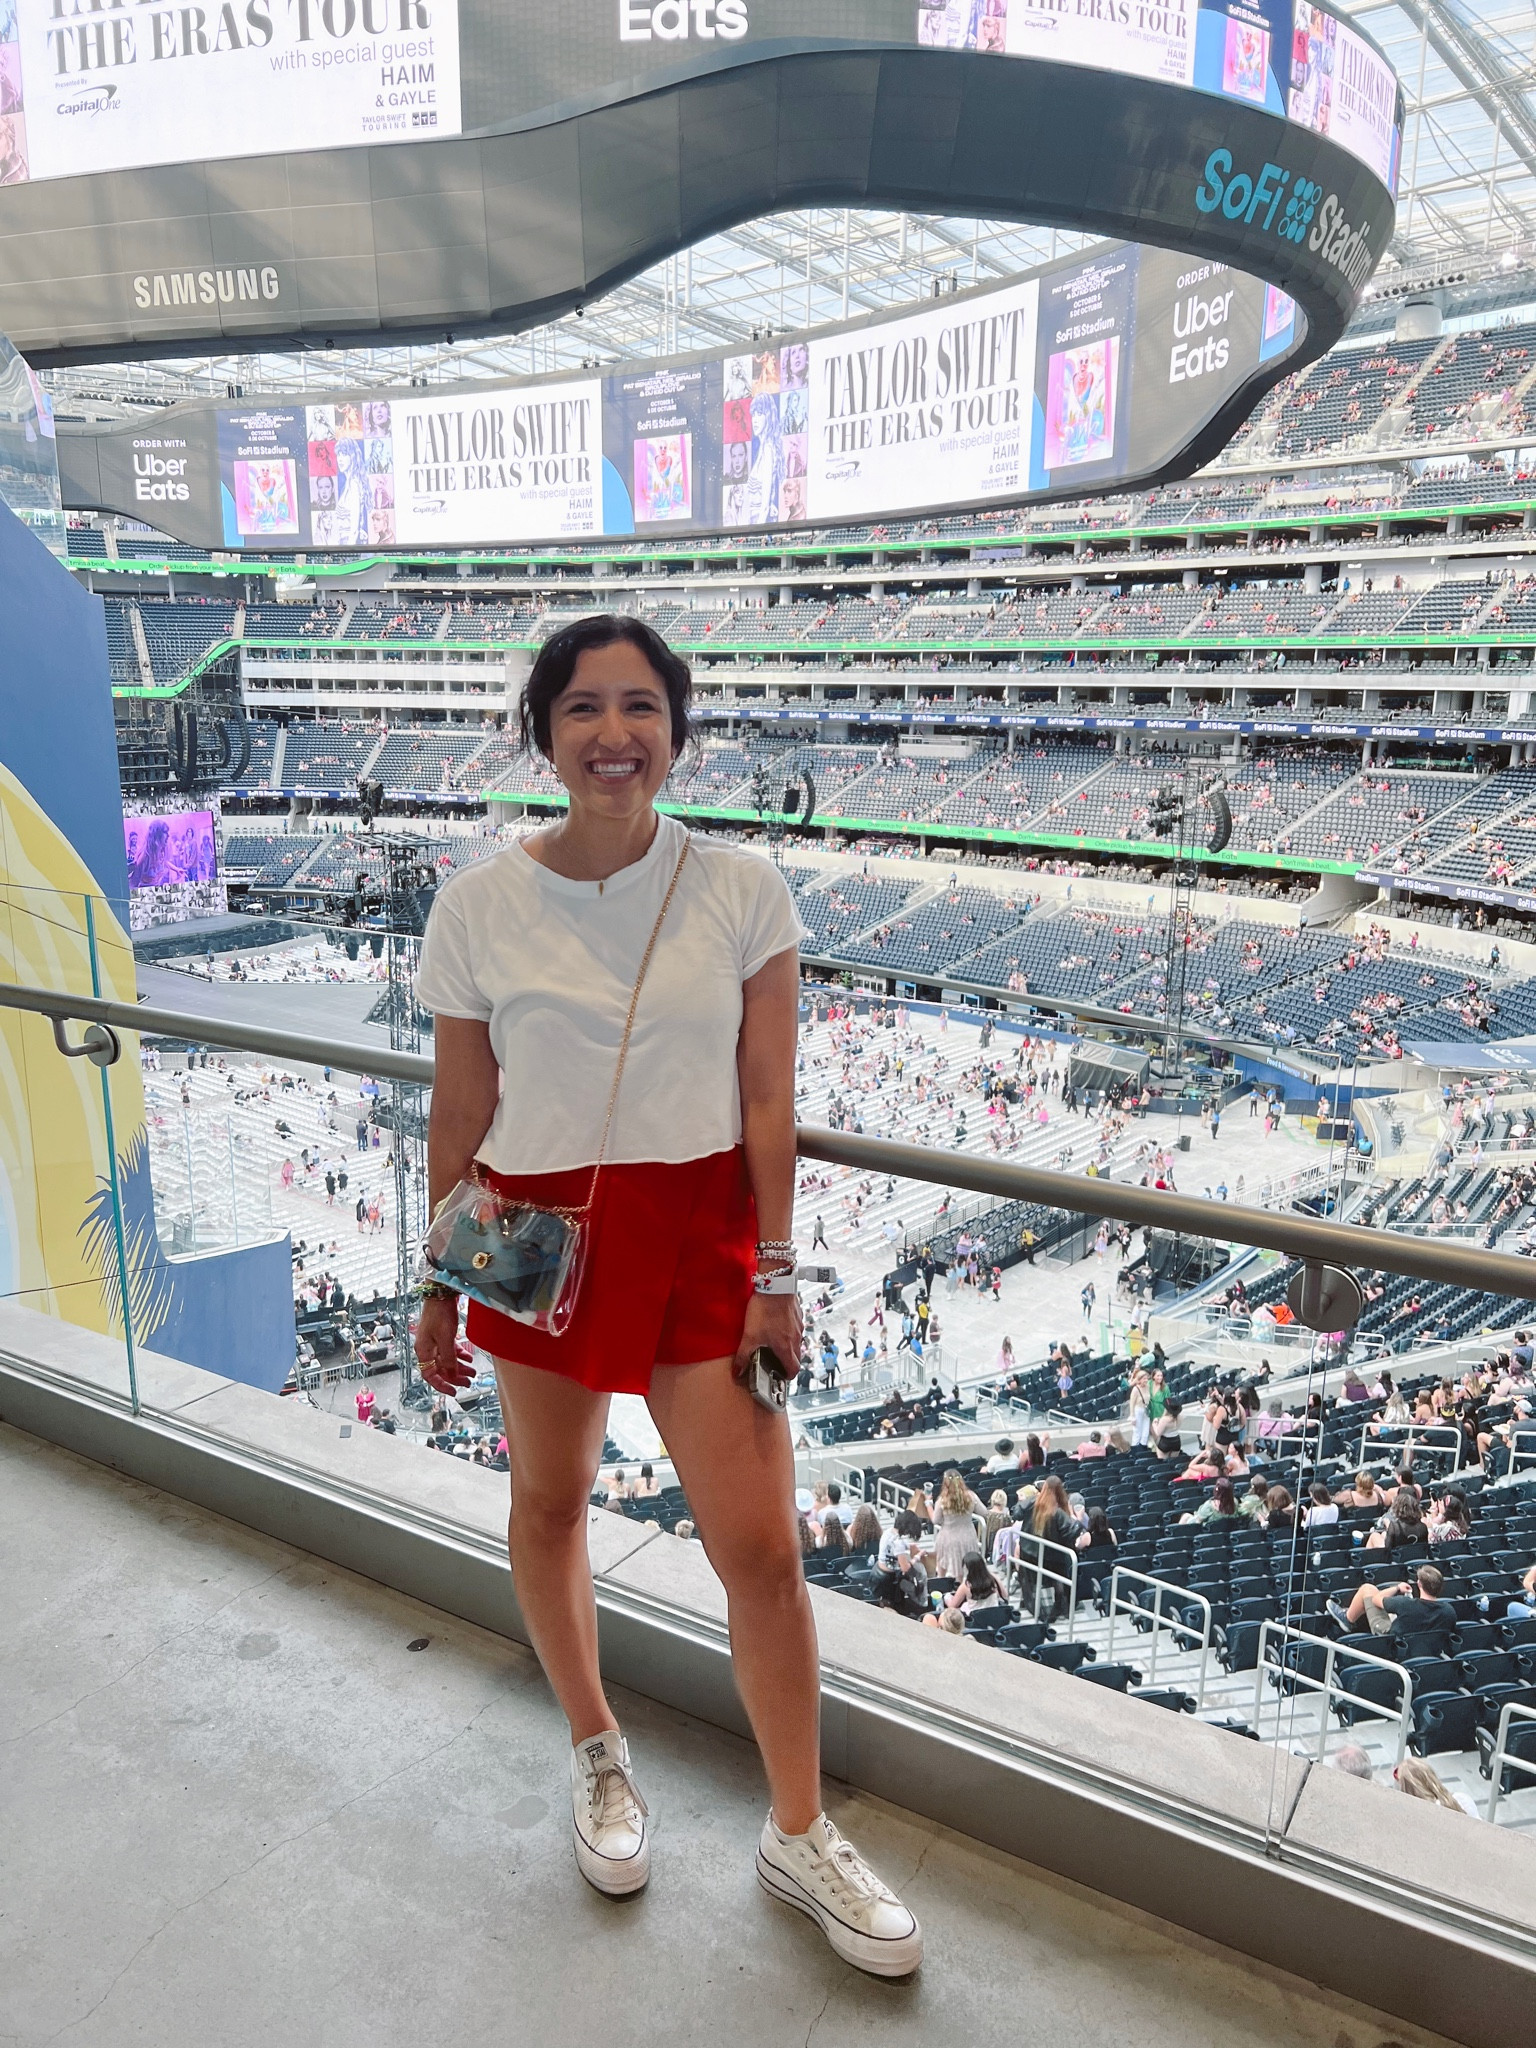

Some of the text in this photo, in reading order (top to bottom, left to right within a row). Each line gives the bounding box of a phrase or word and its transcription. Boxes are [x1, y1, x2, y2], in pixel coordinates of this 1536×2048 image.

[619, 0, 750, 41] Eats
[1136, 5, 1187, 39] TOUR
[47, 0, 432, 75] THE ERAS TOUR
[1126, 28, 1187, 50] with special guest
[270, 37, 435, 71] with special guest
[1167, 49, 1187, 62] HAIM
[381, 63, 435, 86] HAIM
[1342, 37, 1376, 102] TAYLOR
[55, 78, 87, 89] Presented By
[375, 89, 437, 107] & GAYLE
[362, 113, 406, 123] TAYLOR SWIFT
[362, 121, 407, 132] TOURING
[1196, 148, 1290, 231] SoFi
[1309, 194, 1373, 295] Stadium
[1176, 265, 1210, 289] ORDER
[133, 267, 280, 308] SAMSUNG
[1173, 290, 1234, 338] Uber
[1055, 317, 1115, 344] SoFi Stadium
[824, 308, 1024, 420] TAYLOR SWIFT
[1169, 336, 1230, 383] Eats
[637, 417, 688, 431] SoFi Stadium
[824, 388, 1020, 454] THE ERAS TOUR
[406, 399, 590, 464] TAYLOR SWIFT
[939, 426, 1020, 453] with special guest
[133, 439, 186, 448] ORDER WITH
[237, 445, 289, 455] SoFi Stadium
[993, 443, 1019, 460] HAIM
[133, 454, 187, 476] Uber
[988, 461, 1018, 474] & GAYLE
[409, 457, 591, 492] THE ERAS TOUR
[135, 478, 190, 500] Eats
[520, 486, 592, 500] with special guest
[569, 498, 593, 509] HAIM
[572, 511, 593, 519] GAYLE
[1200, 722, 1211, 730] SoFi
[1254, 723, 1297, 733] SoFi Stadium
[1311, 725, 1356, 735] SoFi Stadium
[1372, 726, 1418, 737] SoFi Stadium
[1435, 728, 1485, 739] SoFi Stadium
[1502, 732, 1515, 740] SoFi
[1110, 842, 1128, 850] pickup
[1355, 872, 1379, 883] Stadium
[1394, 877, 1440, 892] SoFi Stadium
[1456, 887, 1504, 903] SoFi Stadium
[1518, 897, 1530, 908] SoFi
